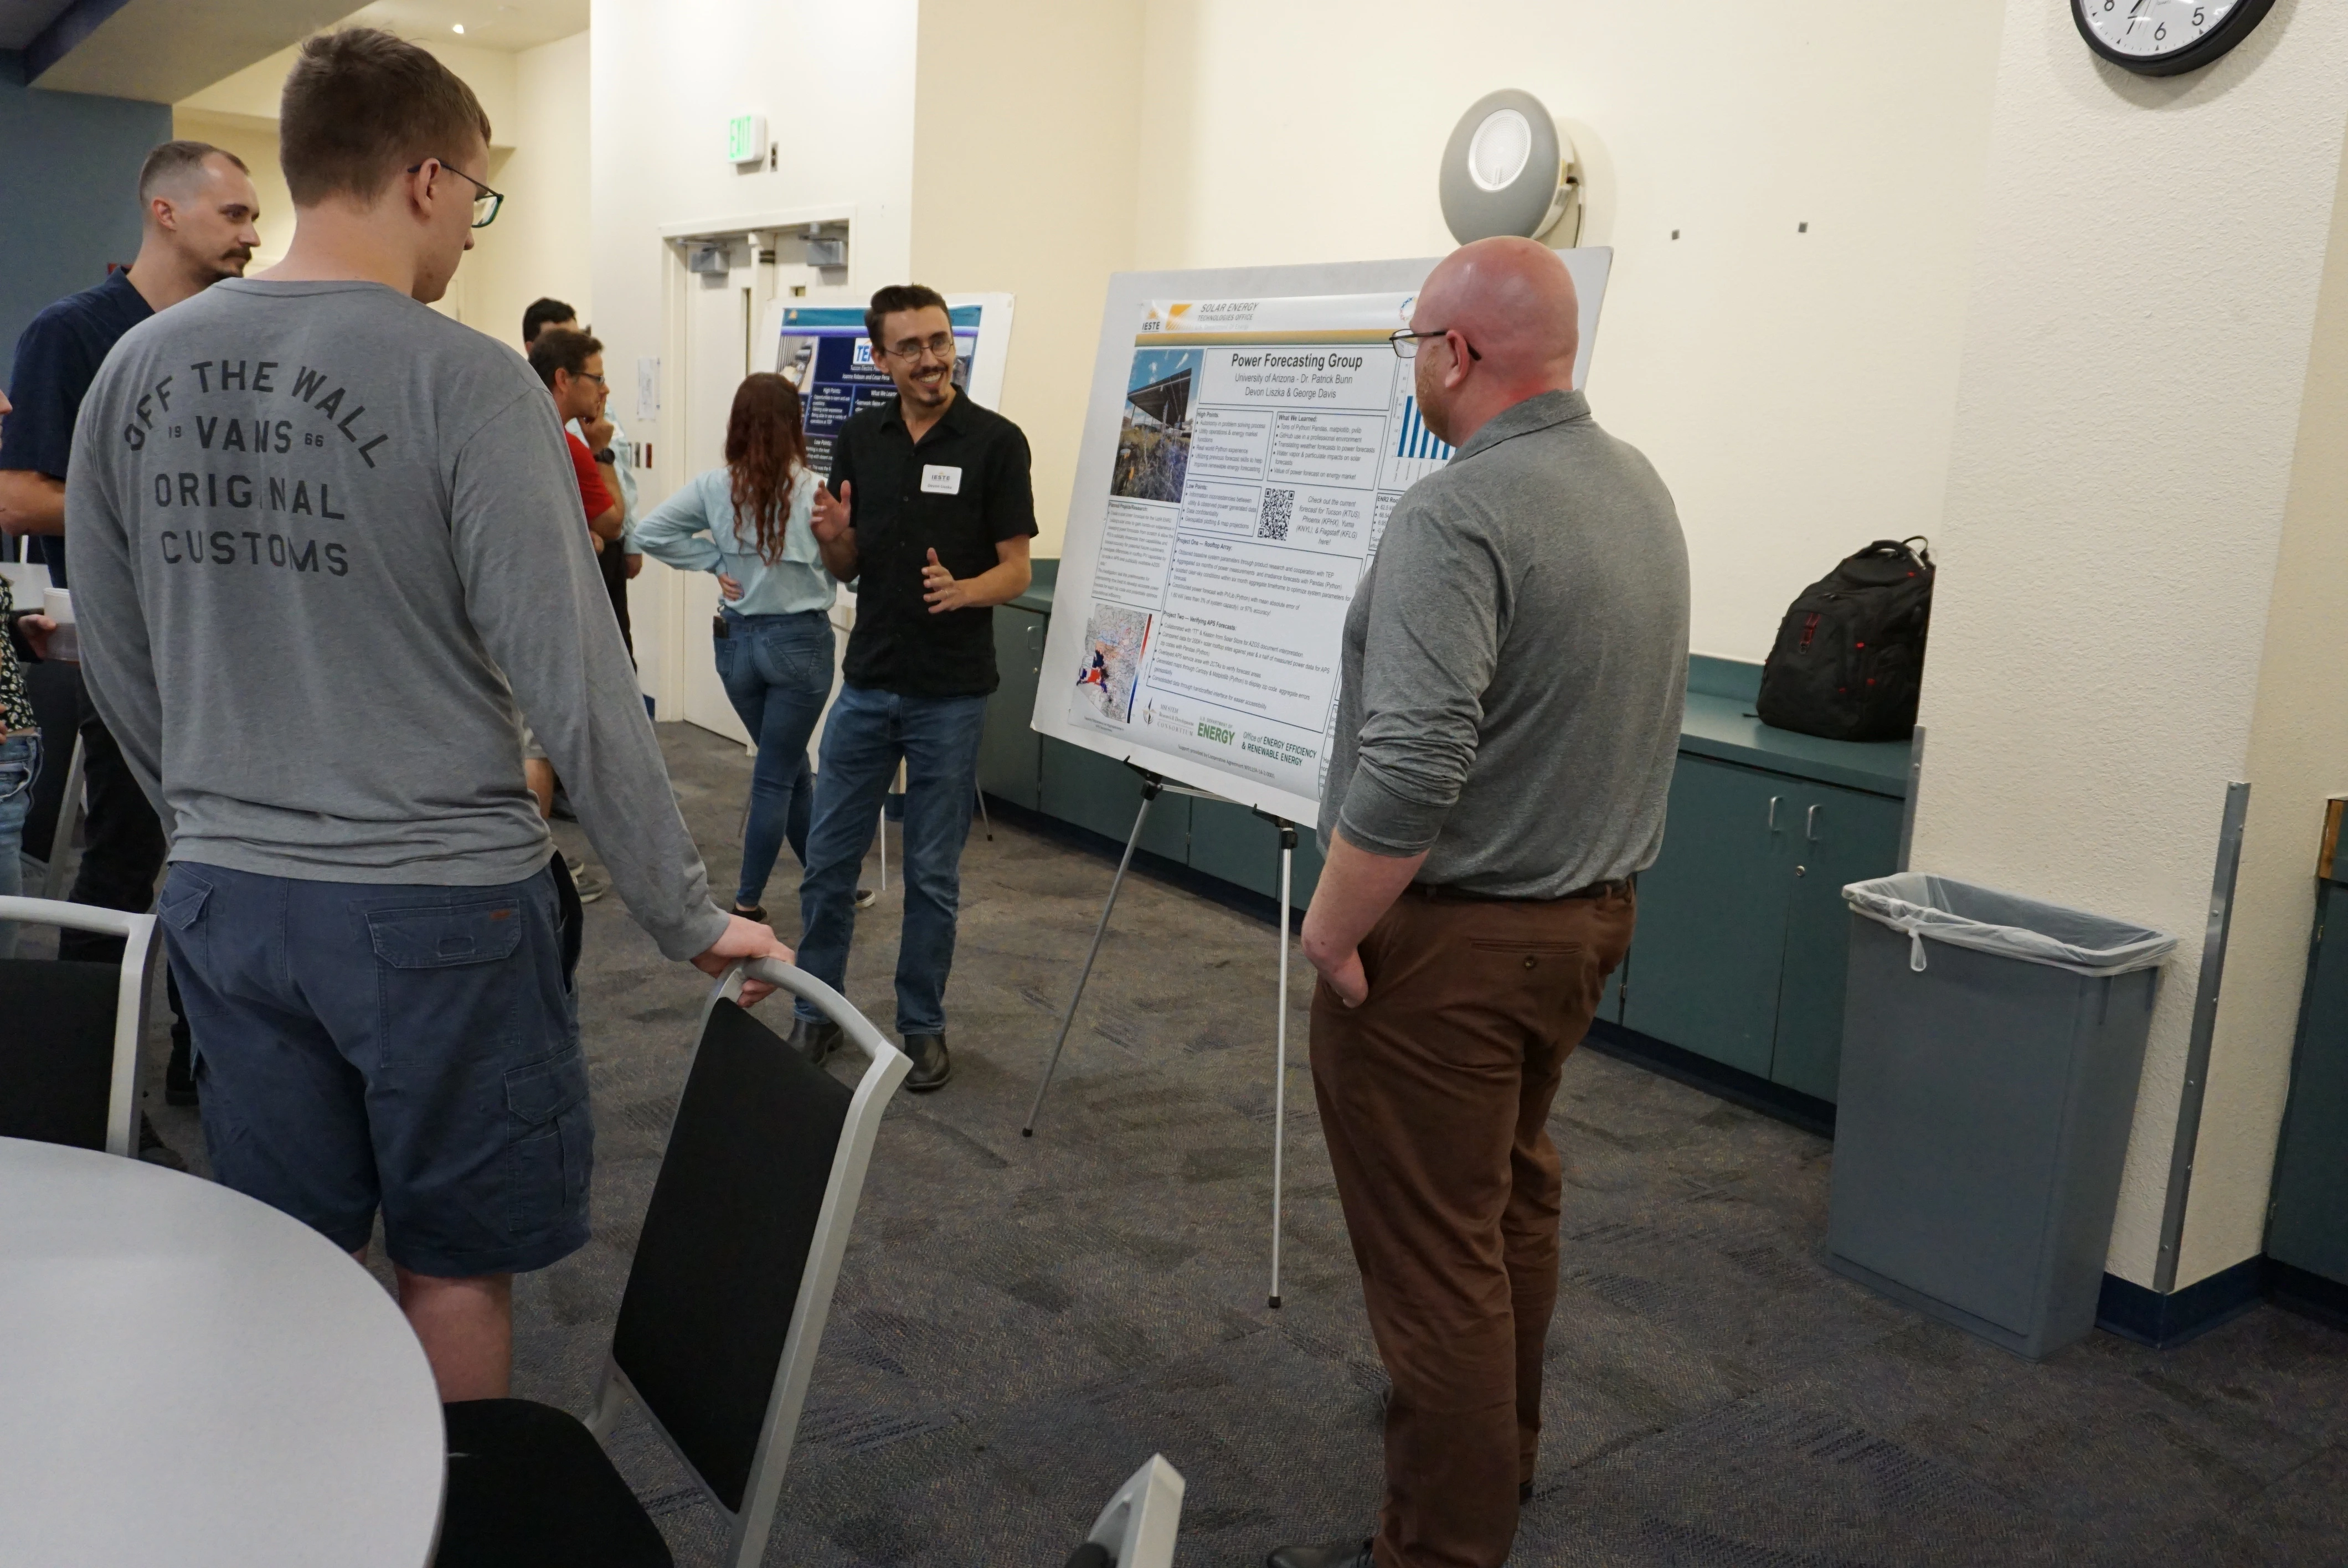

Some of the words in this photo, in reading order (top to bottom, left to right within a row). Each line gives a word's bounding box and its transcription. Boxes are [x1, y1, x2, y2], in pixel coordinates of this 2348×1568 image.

[2128, 15, 2138, 35] 7
[2192, 7, 2205, 26] 5
[2154, 22, 2166, 41] 6
[729, 116, 751, 159] EXIT
[1201, 303, 1225, 312] SOLAR
[1227, 302, 1259, 311] ENERGY
[1142, 322, 1160, 330] IESTE
[1232, 353, 1261, 367] Power
[1264, 353, 1325, 371] Forecasting
[1329, 353, 1362, 371] Group
[1235, 373, 1263, 384] University
[1265, 373, 1271, 382] of
[1271, 374, 1295, 383] Arizona
[1301, 374, 1309, 383] Dr.
[1312, 374, 1333, 383] Patrick
[1336, 375, 1352, 384] Bunn
[1245, 388, 1264, 396] Devon
[1266, 388, 1285, 396] Liszka
[1287, 388, 1291, 397] &
[1293, 388, 1316, 400] George
[1318, 389, 1336, 398] Davis
[123, 375, 173, 451] OFF
[190, 359, 279, 393] THE
[291, 365, 389, 469] WALL
[168, 425, 182, 438] 19
[195, 415, 292, 454] VANS
[305, 433, 324, 447] 66
[155, 473, 345, 520] ORIGNAL
[1302, 515, 1320, 524] Phoenix
[1322, 517, 1339, 527] (KPHX),
[1342, 509, 1360, 519] (KTUS),
[1296, 525, 1313, 534] (KNYL),
[1320, 527, 1340, 537] Flagstaff
[1340, 530, 1357, 540] (KFLG)
[161, 530, 349, 577] CUSTOMS
[1221, 543, 1232, 551] Array:
[1163, 610, 1176, 618] Project
[1190, 616, 1207, 626] Verifying
[1207, 618, 1216, 626] APS
[1217, 622, 1237, 631] Forecasts:
[1197, 722, 1235, 745] ENERGY
[1243, 731, 1257, 742] Office
[1263, 736, 1285, 750] ENERGY
[1286, 742, 1317, 759] EFFICIENCY
[1248, 743, 1279, 760] RENEWABLE
[1281, 753, 1302, 766] ENERGY
